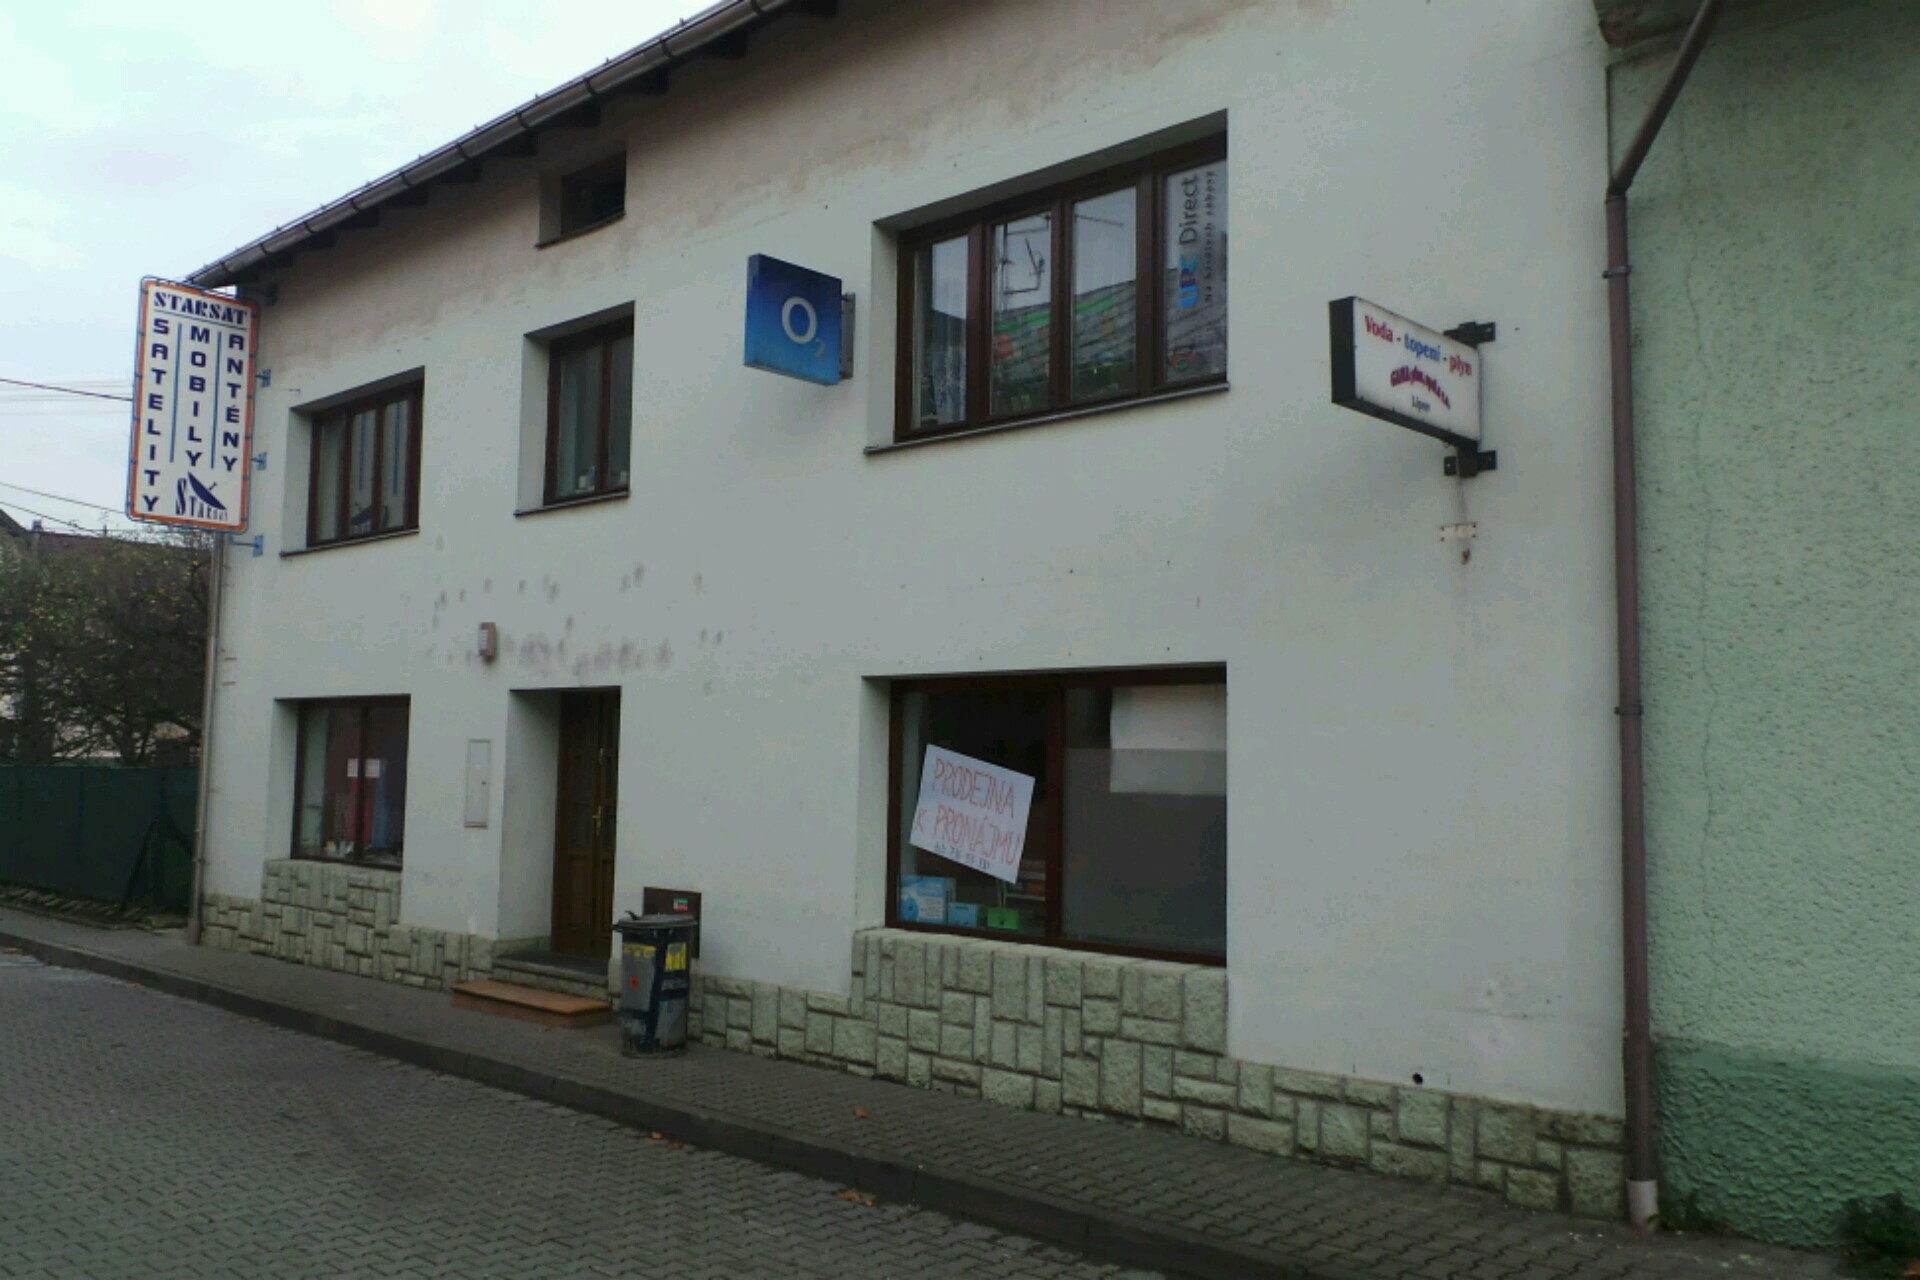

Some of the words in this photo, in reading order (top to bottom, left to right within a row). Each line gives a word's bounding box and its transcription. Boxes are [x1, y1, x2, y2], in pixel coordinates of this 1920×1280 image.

[1179, 174, 1199, 245] Direct
[153, 291, 248, 325] STARSAT
[1364, 314, 1393, 343] Voda
[1449, 354, 1473, 378] plyn
[142, 317, 170, 513] SATELITY
[185, 325, 210, 468] MOBILY
[222, 332, 245, 472] ANTÉNY
[934, 757, 1015, 819] PRODEJNA
[934, 803, 1021, 866] PRONÁJMU
